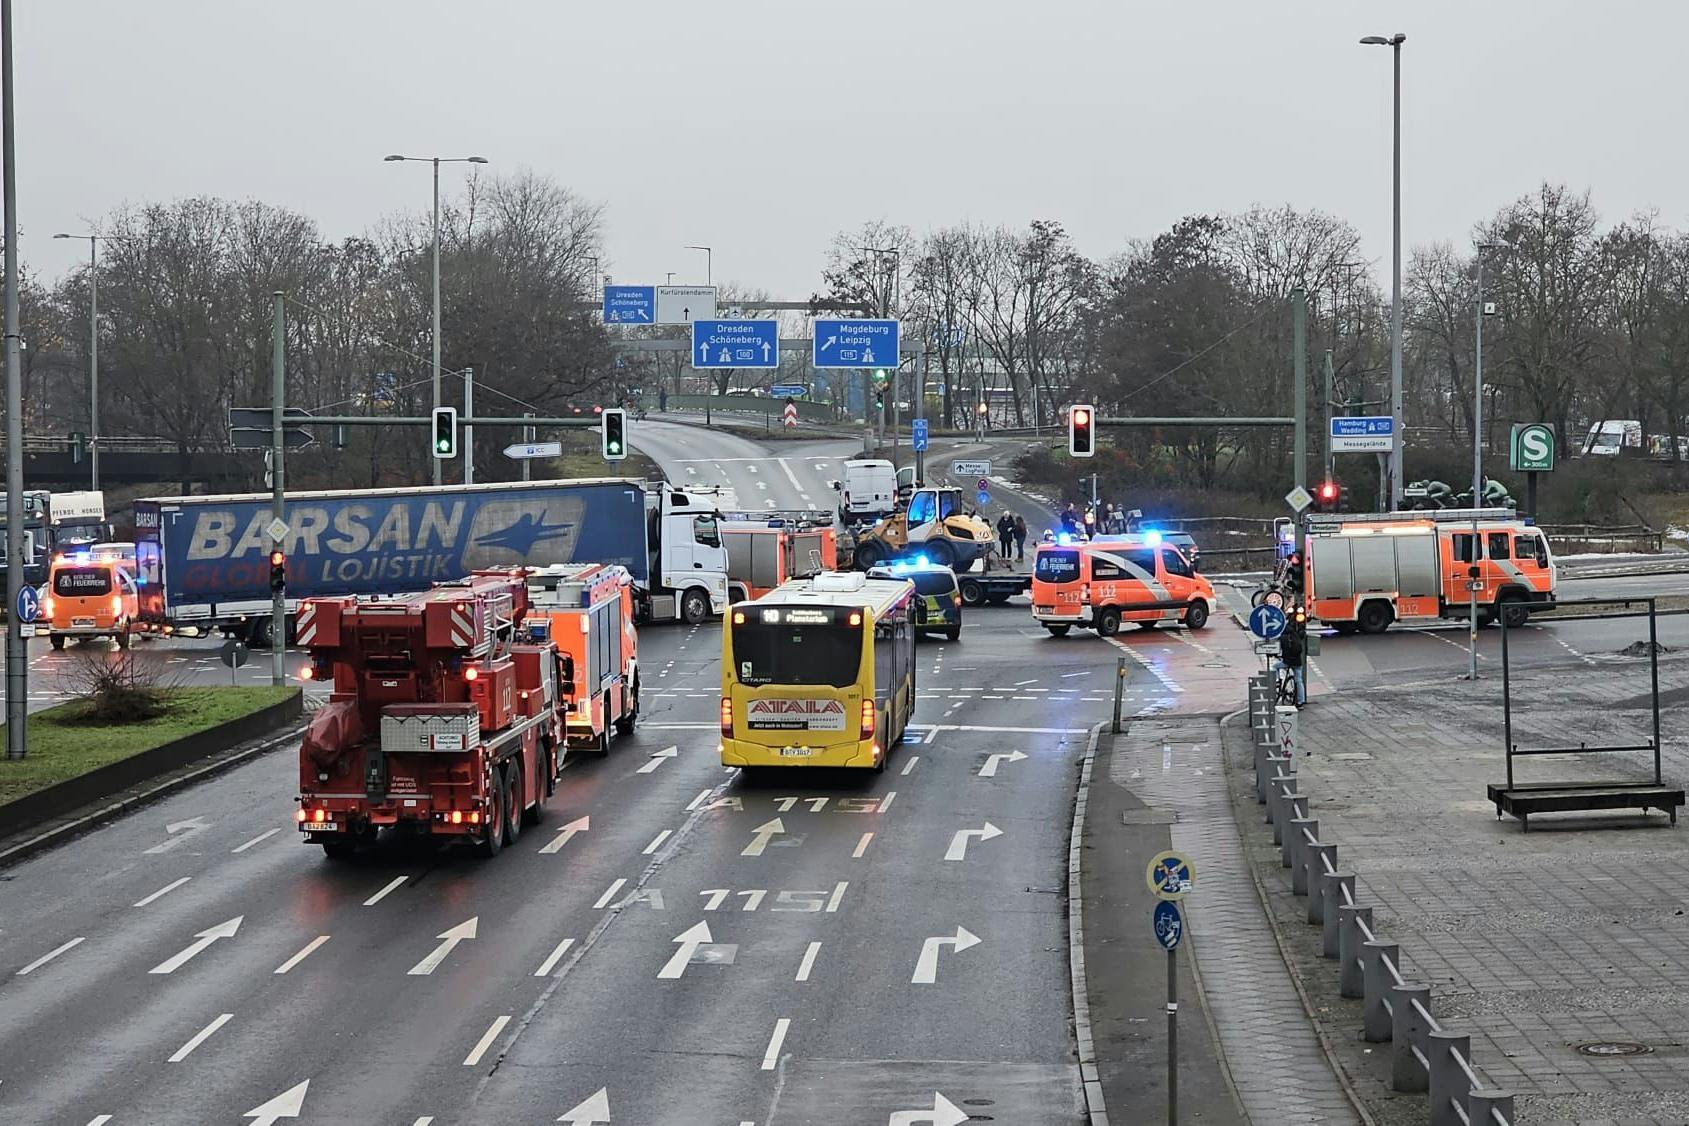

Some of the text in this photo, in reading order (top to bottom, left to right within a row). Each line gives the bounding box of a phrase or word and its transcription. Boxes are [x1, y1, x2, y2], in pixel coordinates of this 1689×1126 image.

[616, 291, 643, 299] Dresden
[717, 324, 754, 333] Dresden
[840, 324, 889, 335] Magdeburg
[709, 335, 762, 345] Schöneberg
[840, 335, 871, 346] Leipzig
[1339, 420, 1367, 428] Hamburg
[1523, 429, 1549, 461] S
[136, 512, 158, 528] BARSAN
[187, 500, 466, 560] BARSAN
[73, 579, 106, 587] FEUERWEHR
[1098, 584, 1116, 598] 112
[750, 700, 843, 714] ATALA
[773, 796, 880, 813] 115
[700, 888, 829, 912] 115
